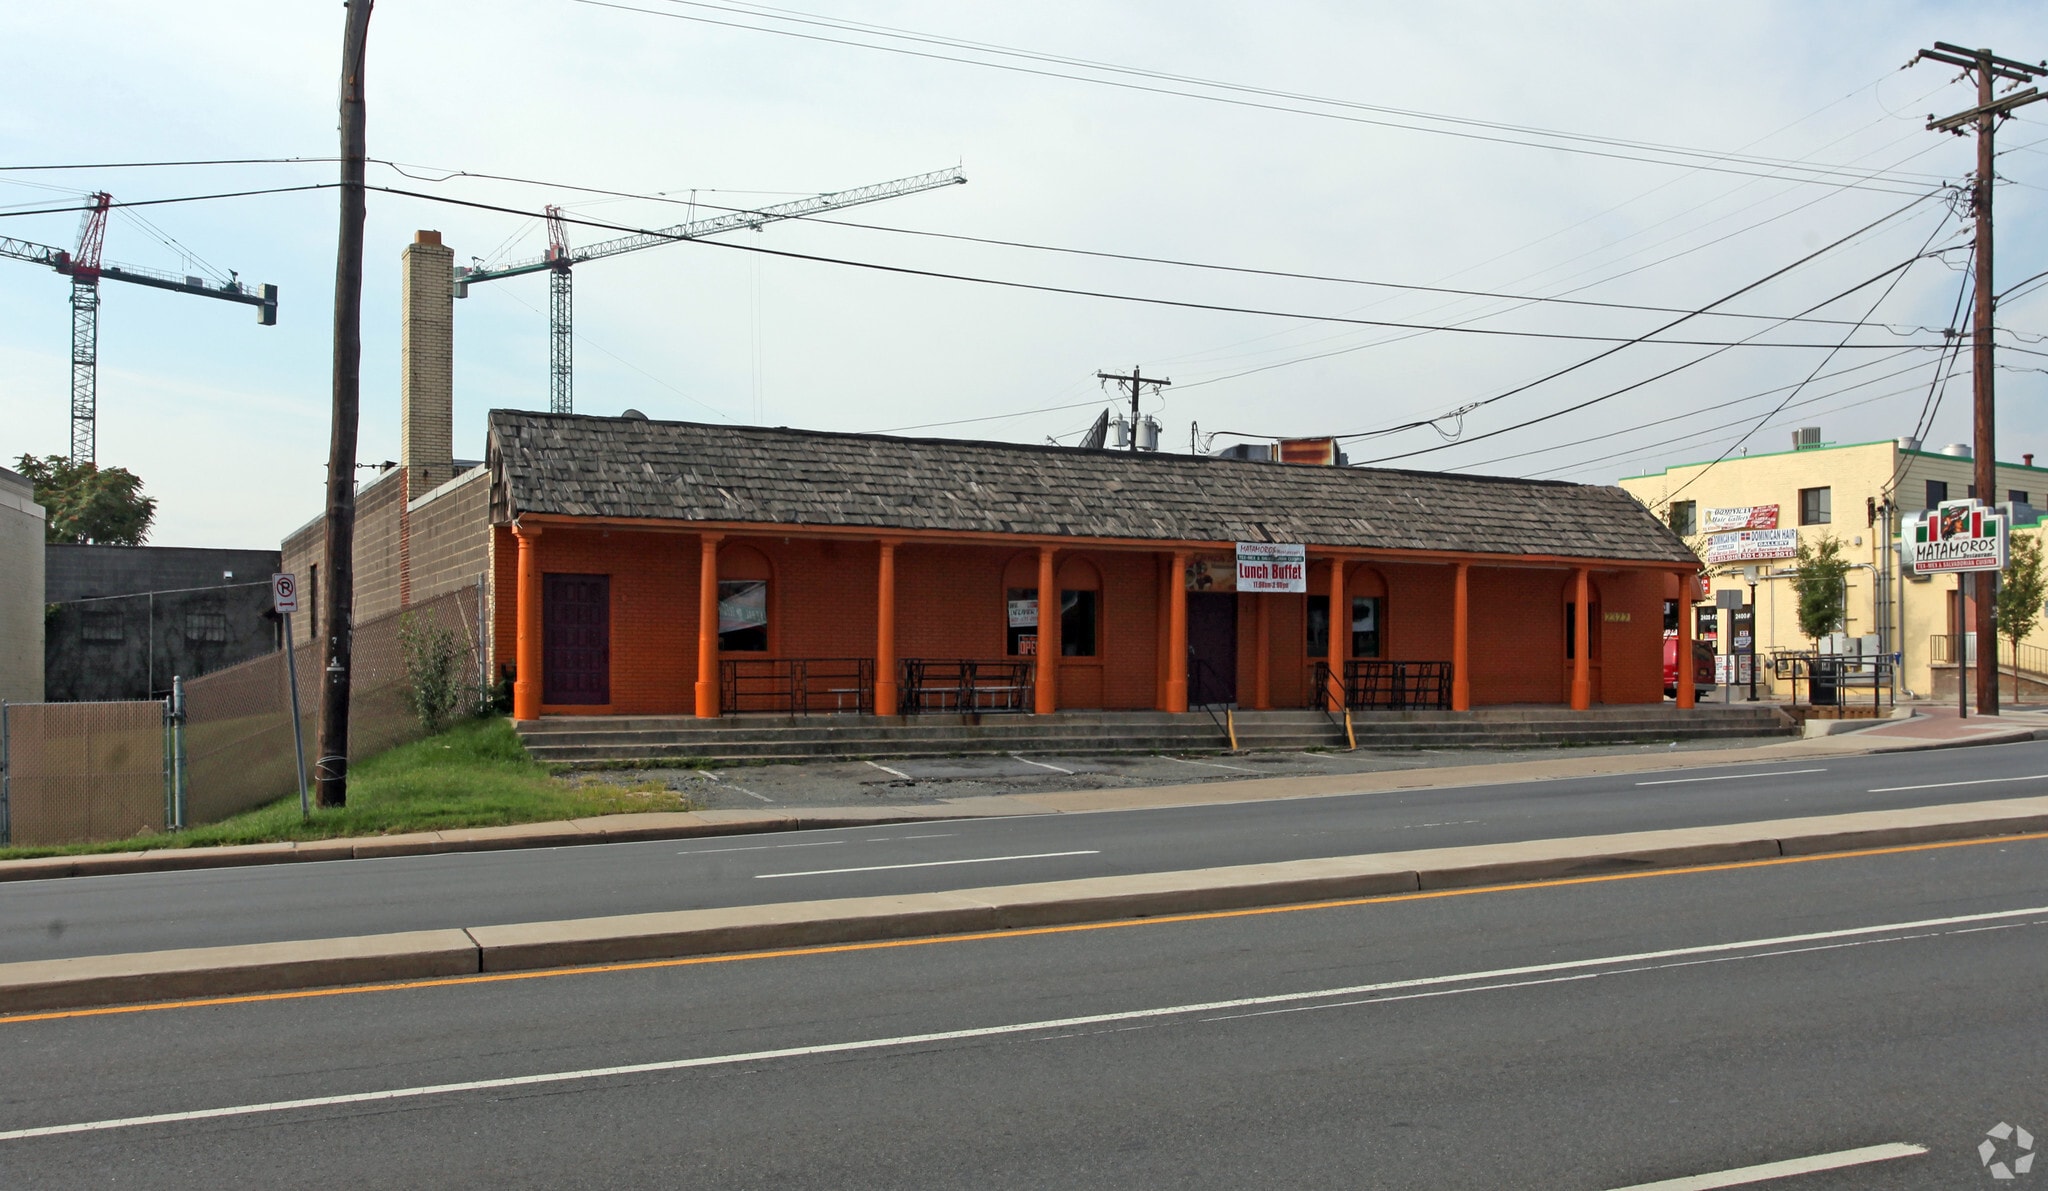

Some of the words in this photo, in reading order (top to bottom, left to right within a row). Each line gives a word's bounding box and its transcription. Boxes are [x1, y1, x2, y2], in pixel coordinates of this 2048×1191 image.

[1751, 529, 1780, 541] DOMINICAN
[1781, 528, 1795, 539] HAIR
[1241, 545, 1276, 553] MATAMOROS
[1916, 538, 1995, 561] MATAMOROS
[1976, 558, 1994, 566] CUISINE
[1239, 563, 1268, 578] Lunch
[1272, 564, 1302, 579] Buffet
[1020, 641, 1037, 655] OPE
